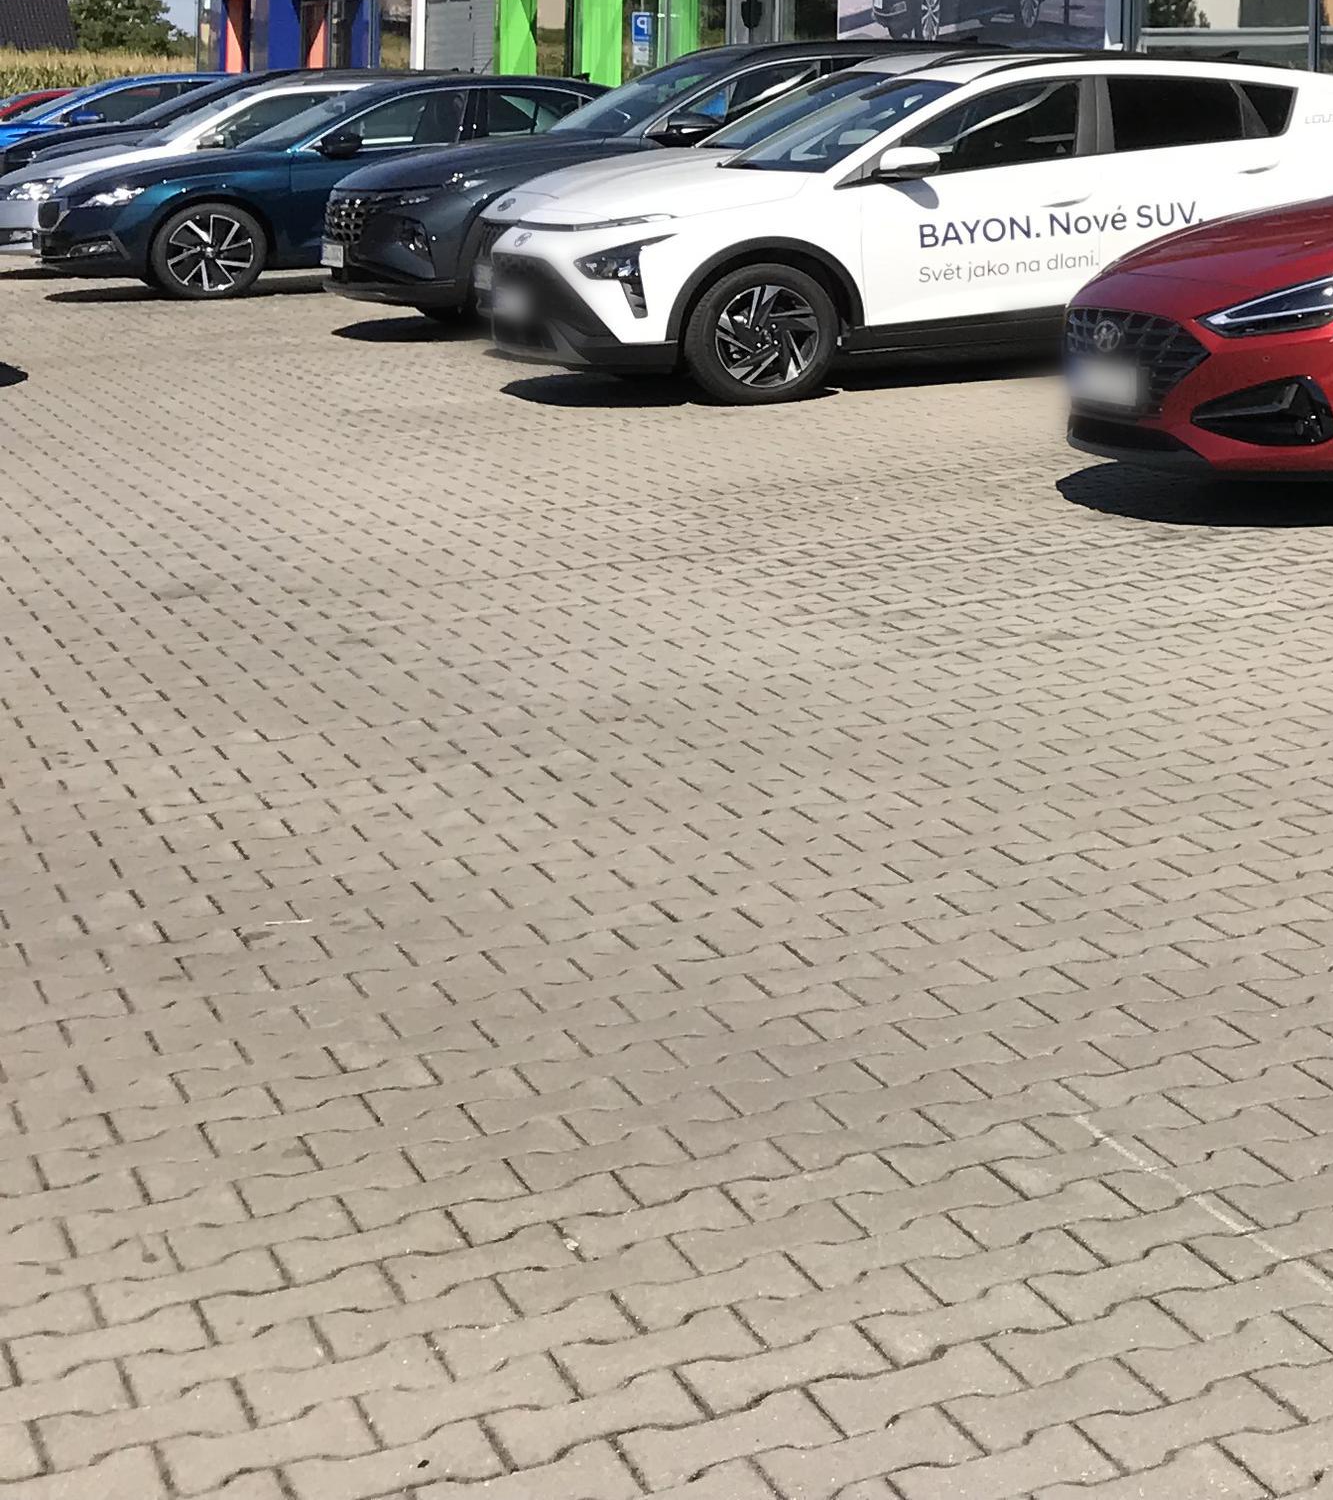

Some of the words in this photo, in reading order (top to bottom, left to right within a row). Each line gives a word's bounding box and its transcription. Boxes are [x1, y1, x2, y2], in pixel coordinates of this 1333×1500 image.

[918, 215, 1041, 248] BAYON.
[1049, 205, 1127, 237] Nové
[919, 262, 962, 283] Svět
[968, 258, 1010, 282] jako
[1016, 257, 1040, 274] na
[1046, 250, 1100, 271] dlani.
